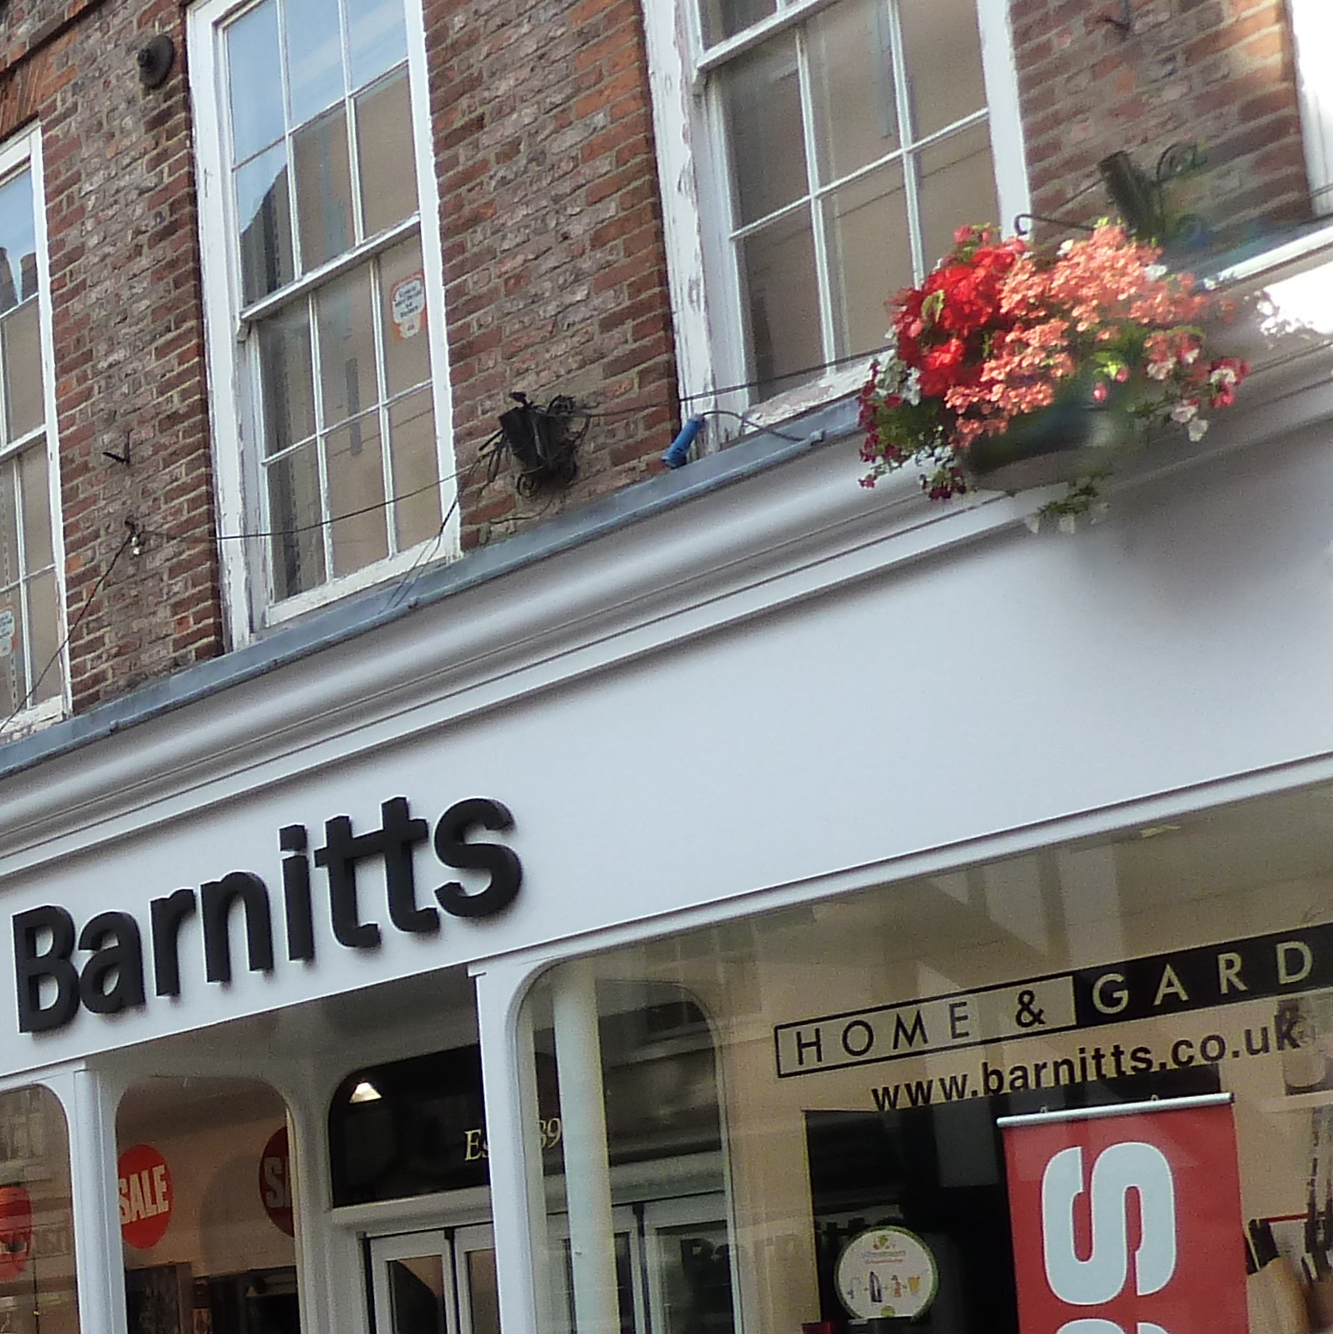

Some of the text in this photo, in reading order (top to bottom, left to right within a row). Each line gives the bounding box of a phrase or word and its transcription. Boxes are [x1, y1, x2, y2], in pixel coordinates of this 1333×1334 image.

[11, 796, 525, 1034] Barnitts
[796, 1002, 969, 1065] HOME
[1015, 990, 1046, 1028] &
[871, 1017, 1301, 1112] www.barnitts.co.uk
